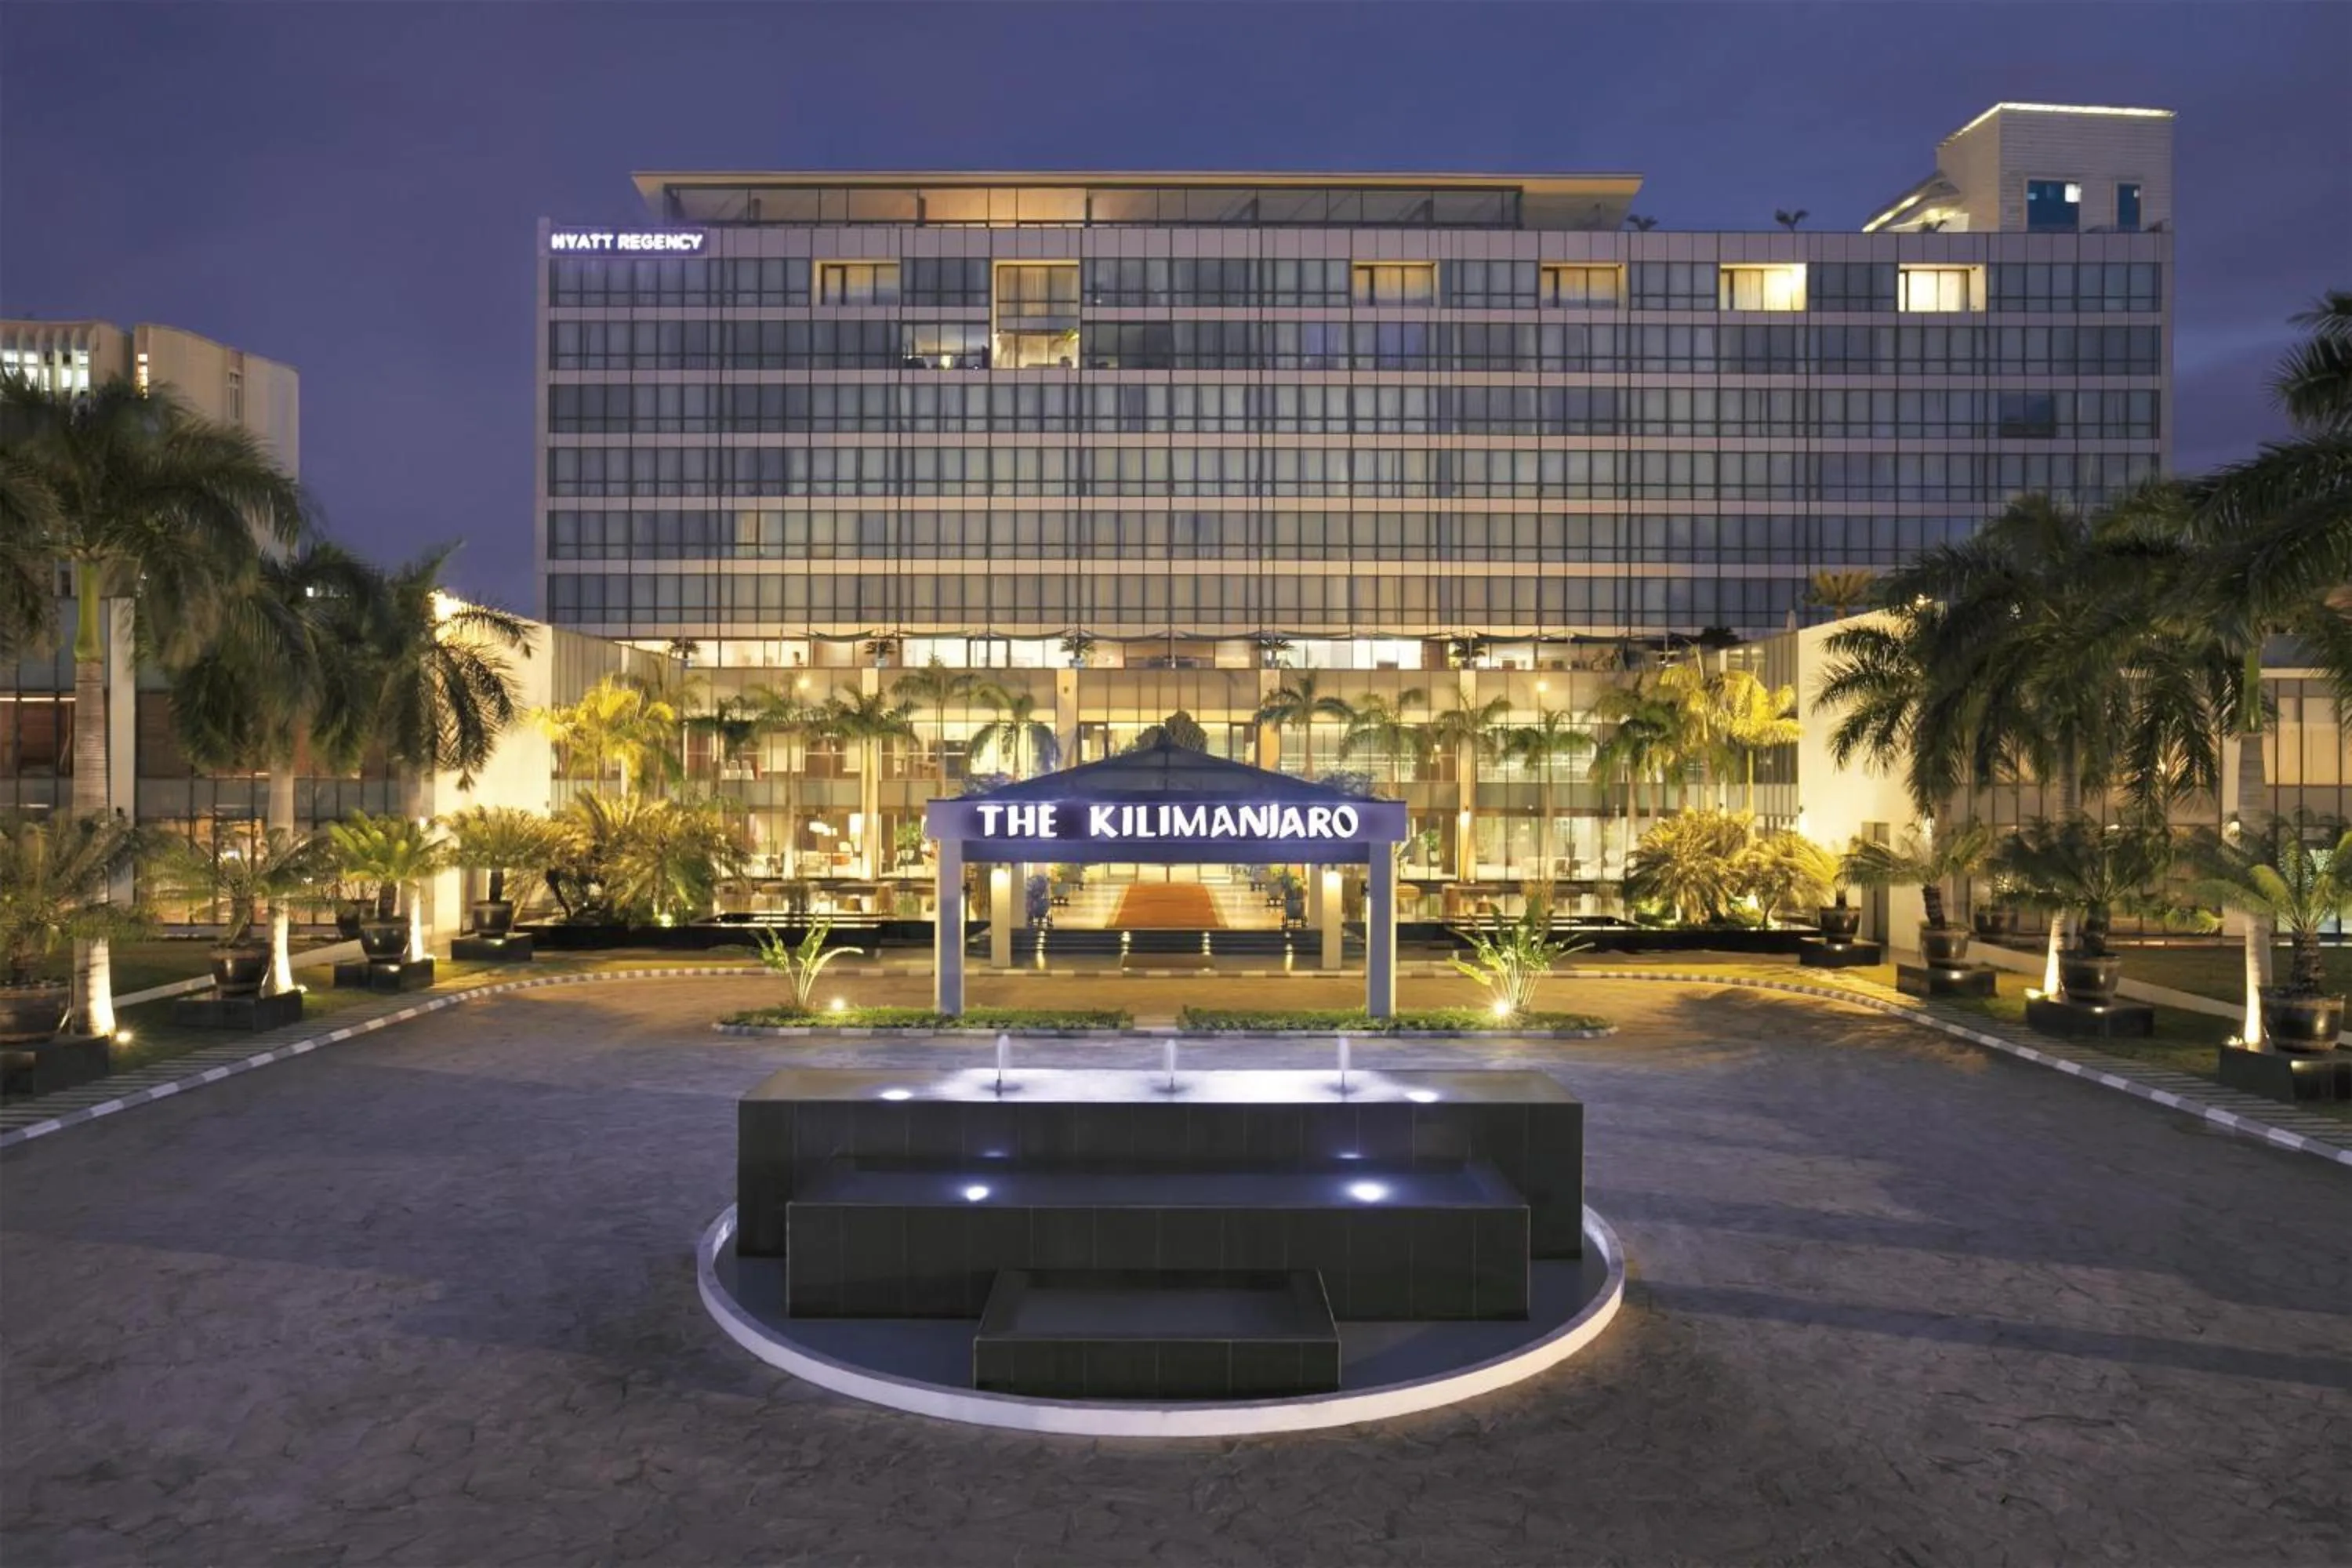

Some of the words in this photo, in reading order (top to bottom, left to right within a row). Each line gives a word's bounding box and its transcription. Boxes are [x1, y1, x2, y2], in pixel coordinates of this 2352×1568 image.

[551, 233, 614, 249] HYATT
[617, 233, 703, 249] REGENCY
[976, 804, 1058, 837] THE
[1089, 804, 1359, 839] KILIMANJARO
